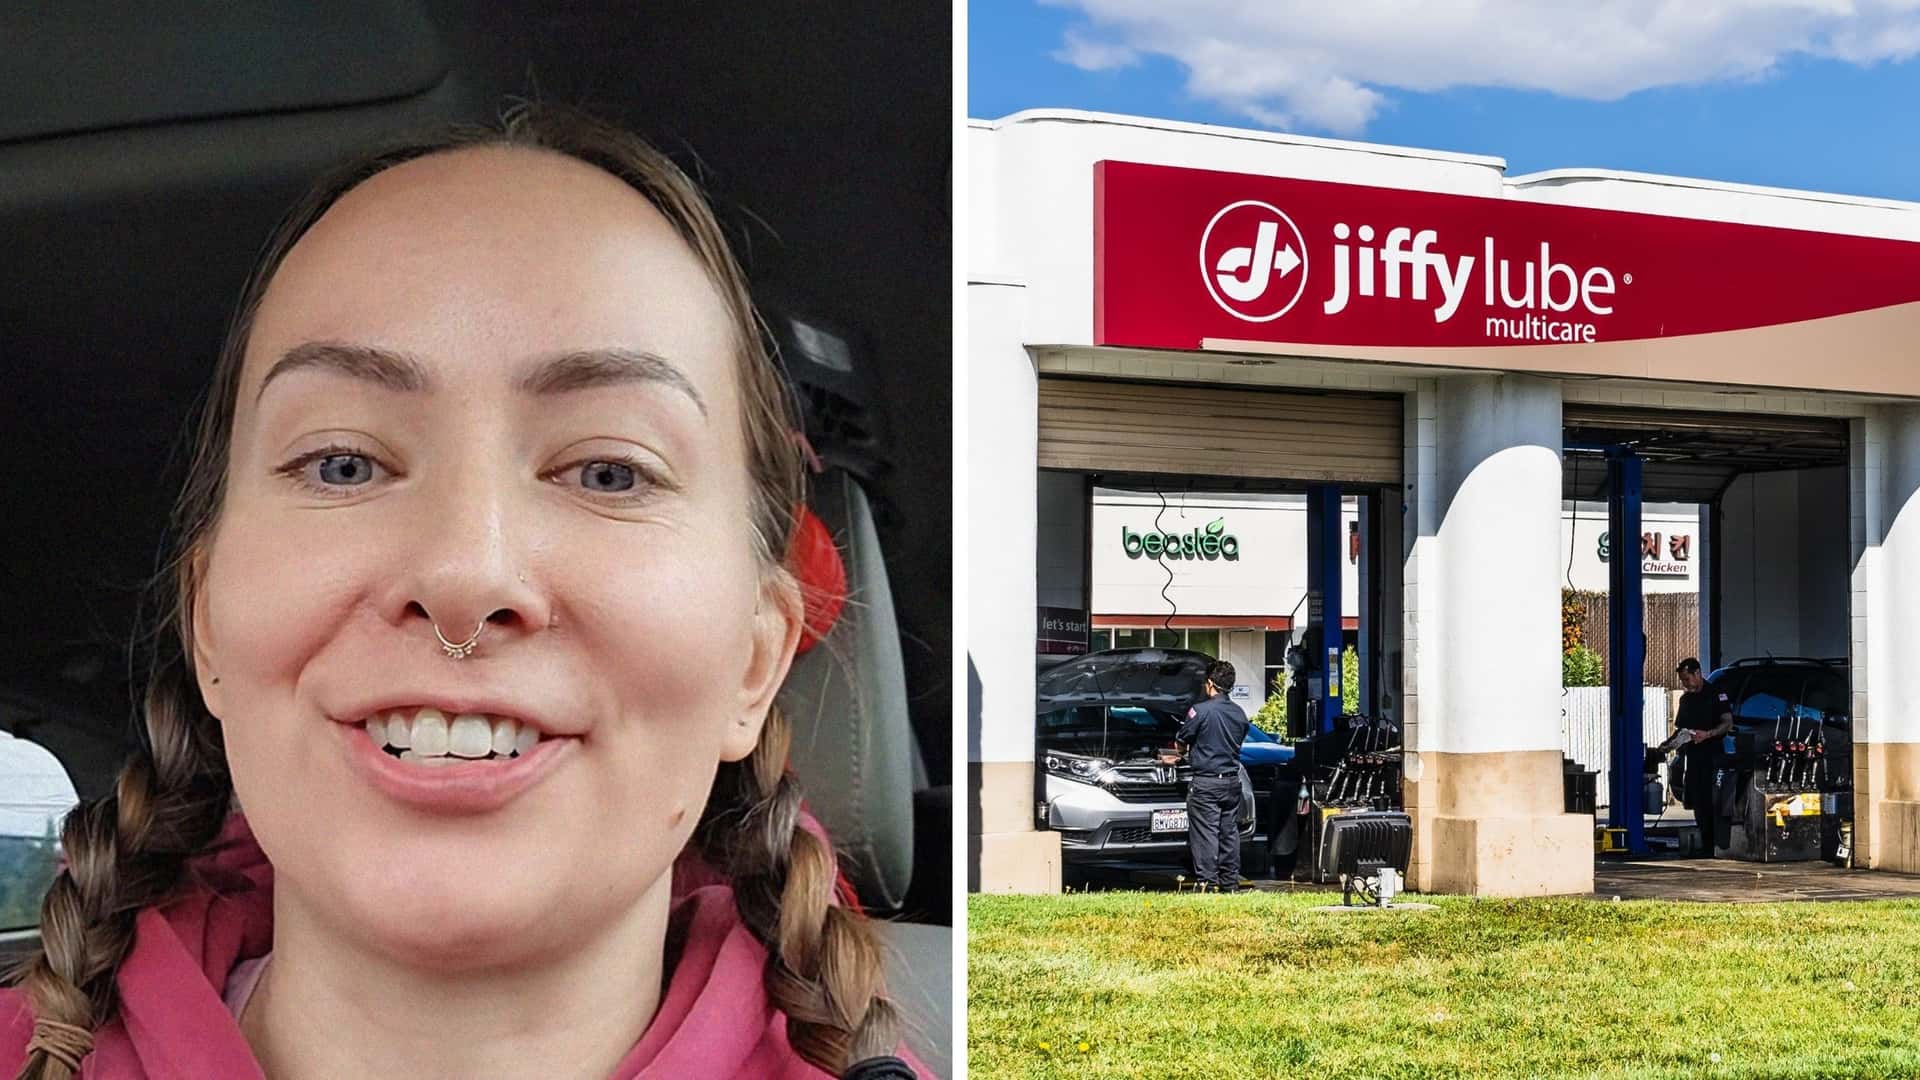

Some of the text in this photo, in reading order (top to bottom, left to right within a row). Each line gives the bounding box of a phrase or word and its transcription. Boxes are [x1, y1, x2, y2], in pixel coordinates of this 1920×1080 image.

[1323, 223, 1475, 323] jiffy
[1485, 236, 1616, 315] lube
[1486, 313, 1596, 342] multicare
[1642, 561, 1687, 573] Chicken
[1042, 617, 1064, 631] let's
